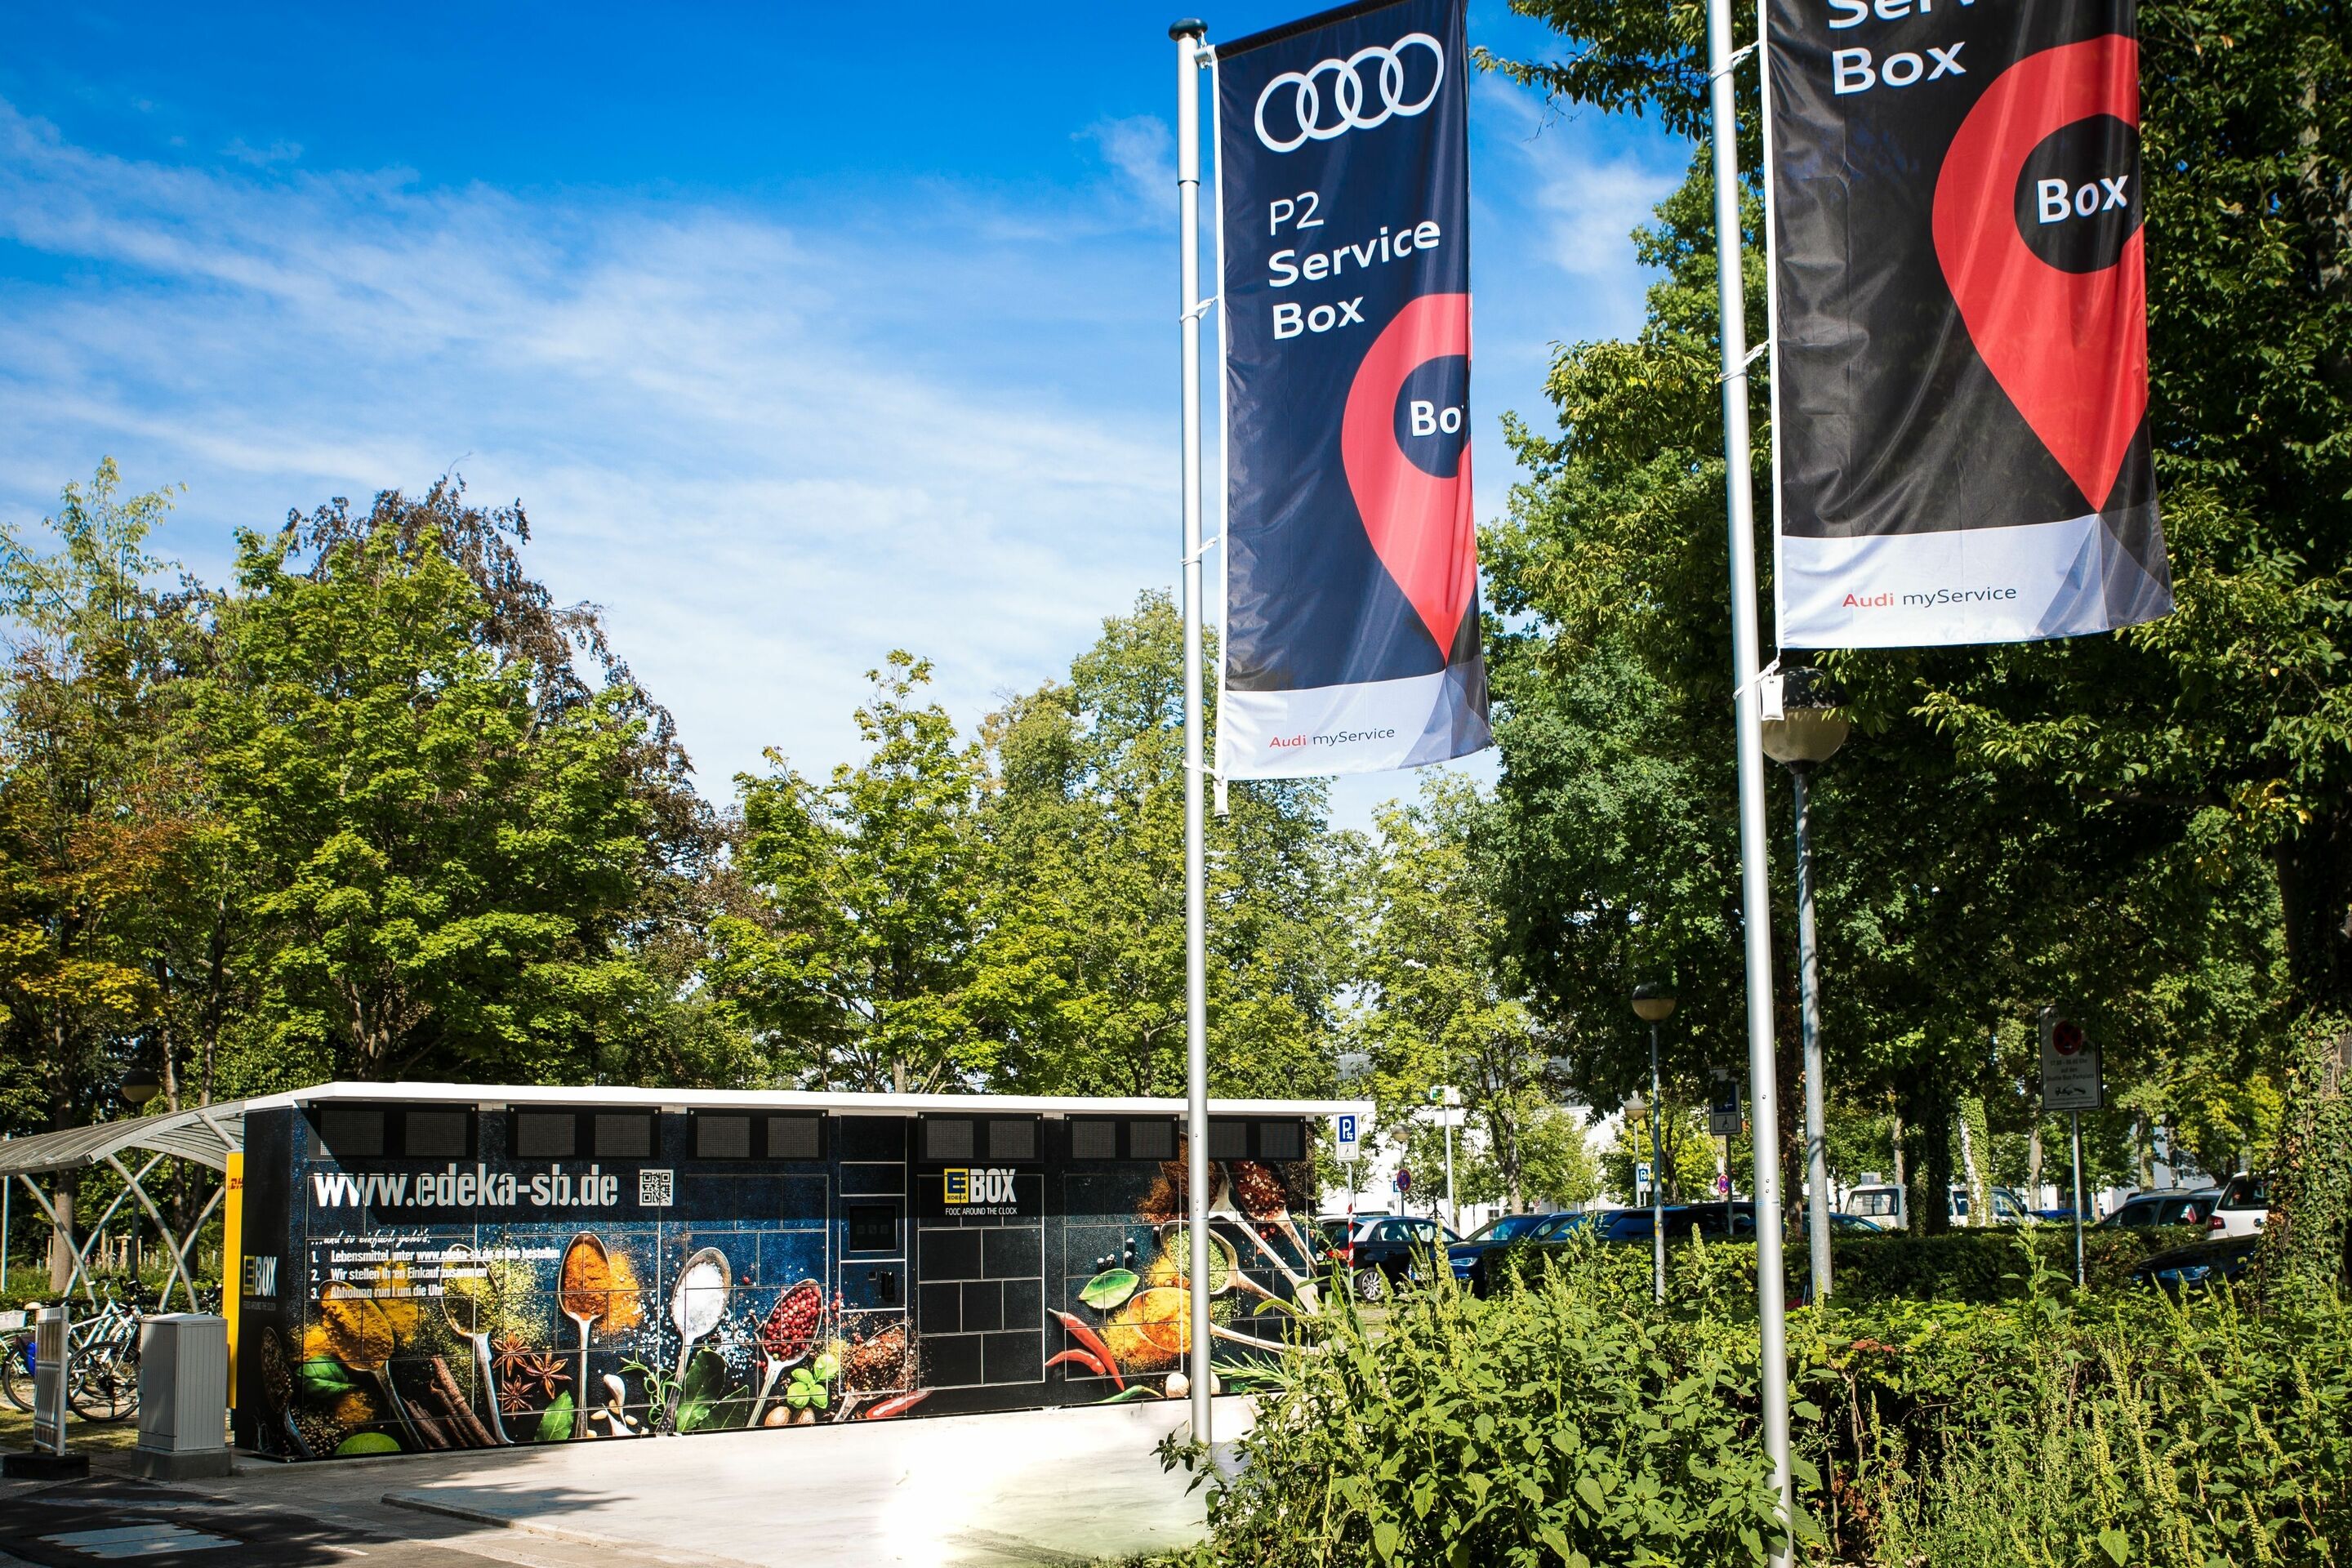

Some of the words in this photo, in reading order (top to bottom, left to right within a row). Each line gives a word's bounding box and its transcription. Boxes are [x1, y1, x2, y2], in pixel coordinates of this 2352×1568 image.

[1832, 42, 1966, 96] Box
[1270, 191, 1324, 236] P2
[2037, 175, 2128, 224] Box
[1268, 220, 1441, 287] Service
[1272, 296, 1365, 340] Box
[1410, 400, 1464, 437] Bo
[1842, 593, 1894, 607] Audi
[1903, 586, 2017, 608] myService
[1269, 735, 1307, 748] Audi
[1313, 728, 1395, 746] myService
[1343, 1119, 1352, 1138] P
[313, 1163, 618, 1207] www.edeka-sb.de
[962, 1207, 986, 1215] AROUND
[987, 1207, 998, 1215] THE
[999, 1207, 1018, 1215] CLOCK
[310, 1250, 318, 1263] 1.
[331, 1249, 389, 1263] Lebensmittel
[310, 1269, 320, 1281] 2.
[330, 1268, 347, 1281] Wir
[349, 1267, 380, 1281] stellen
[382, 1267, 405, 1280] Ihren
[408, 1266, 440, 1279] Einkauf
[441, 1267, 488, 1279] zusammen
[310, 1287, 319, 1299] 3.
[330, 1285, 372, 1299] Abholung
[397, 1287, 412, 1298] um
[413, 1285, 427, 1297] die
[428, 1284, 445, 1297] Uhr
